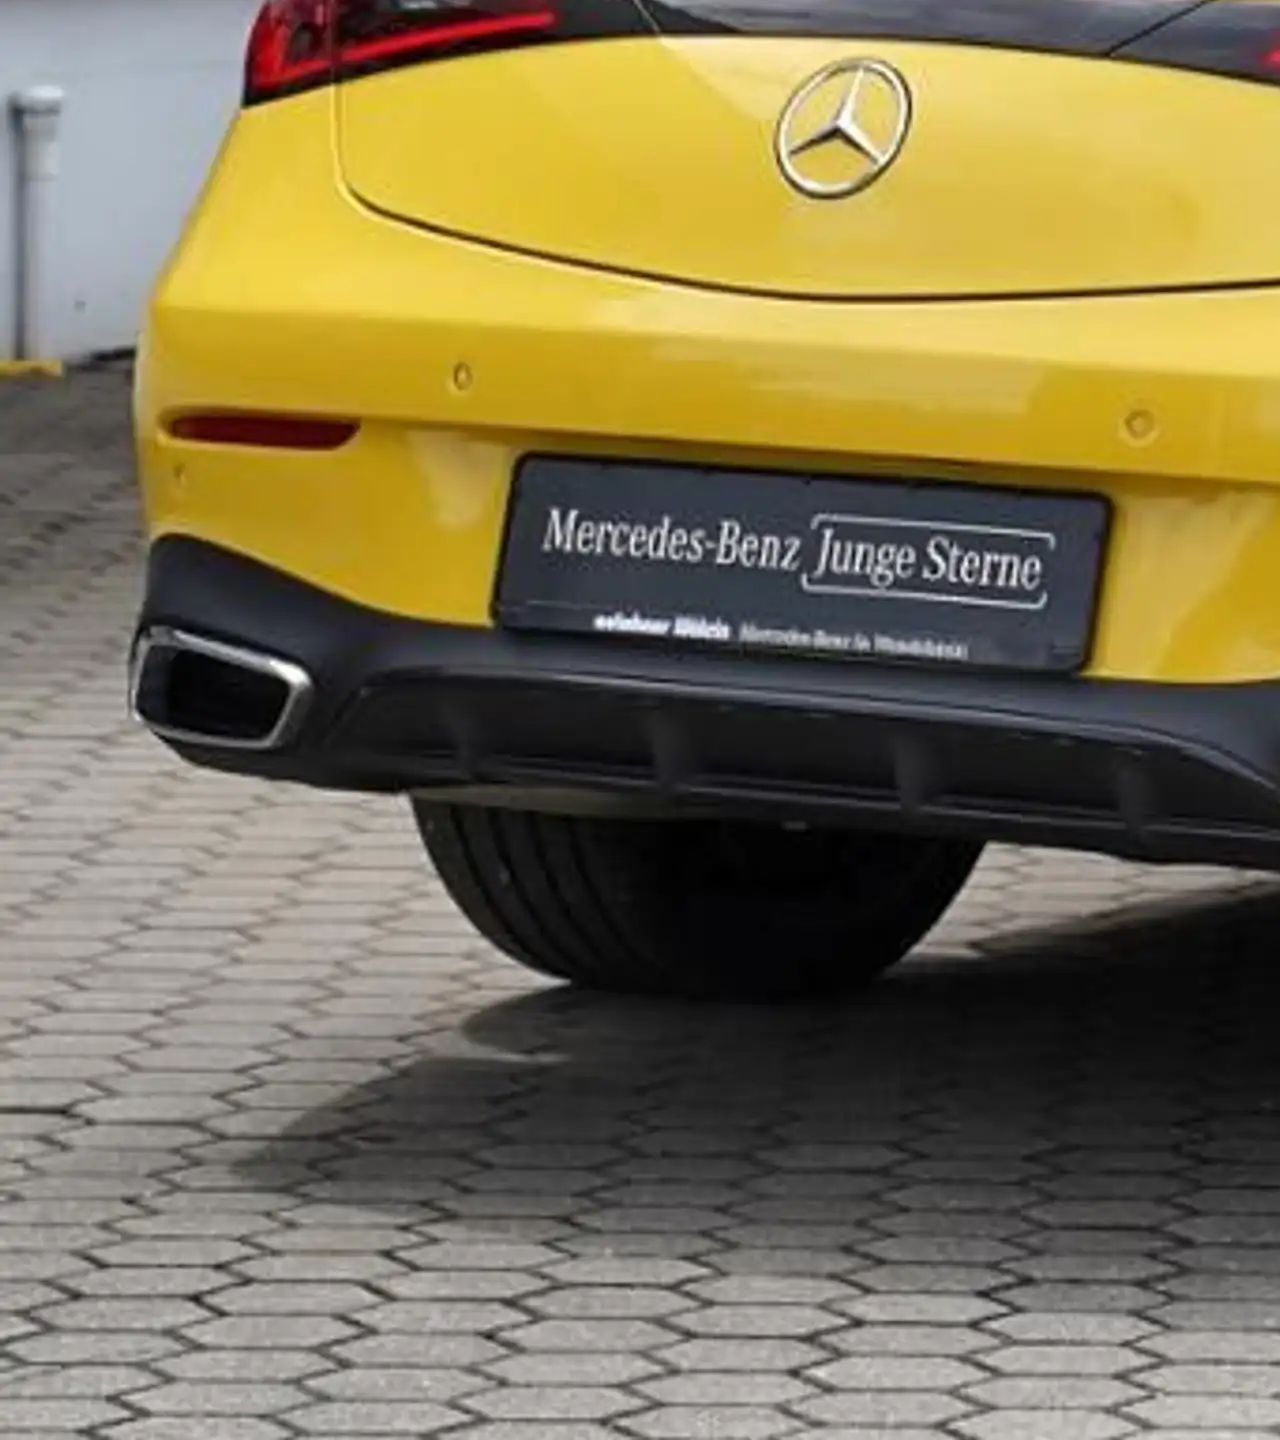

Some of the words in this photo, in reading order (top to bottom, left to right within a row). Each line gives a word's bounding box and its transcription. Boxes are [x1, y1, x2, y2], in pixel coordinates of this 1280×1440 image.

[542, 506, 800, 572] Mercedes-Benz
[812, 528, 916, 588] Junge
[922, 534, 1043, 591] Sterne
